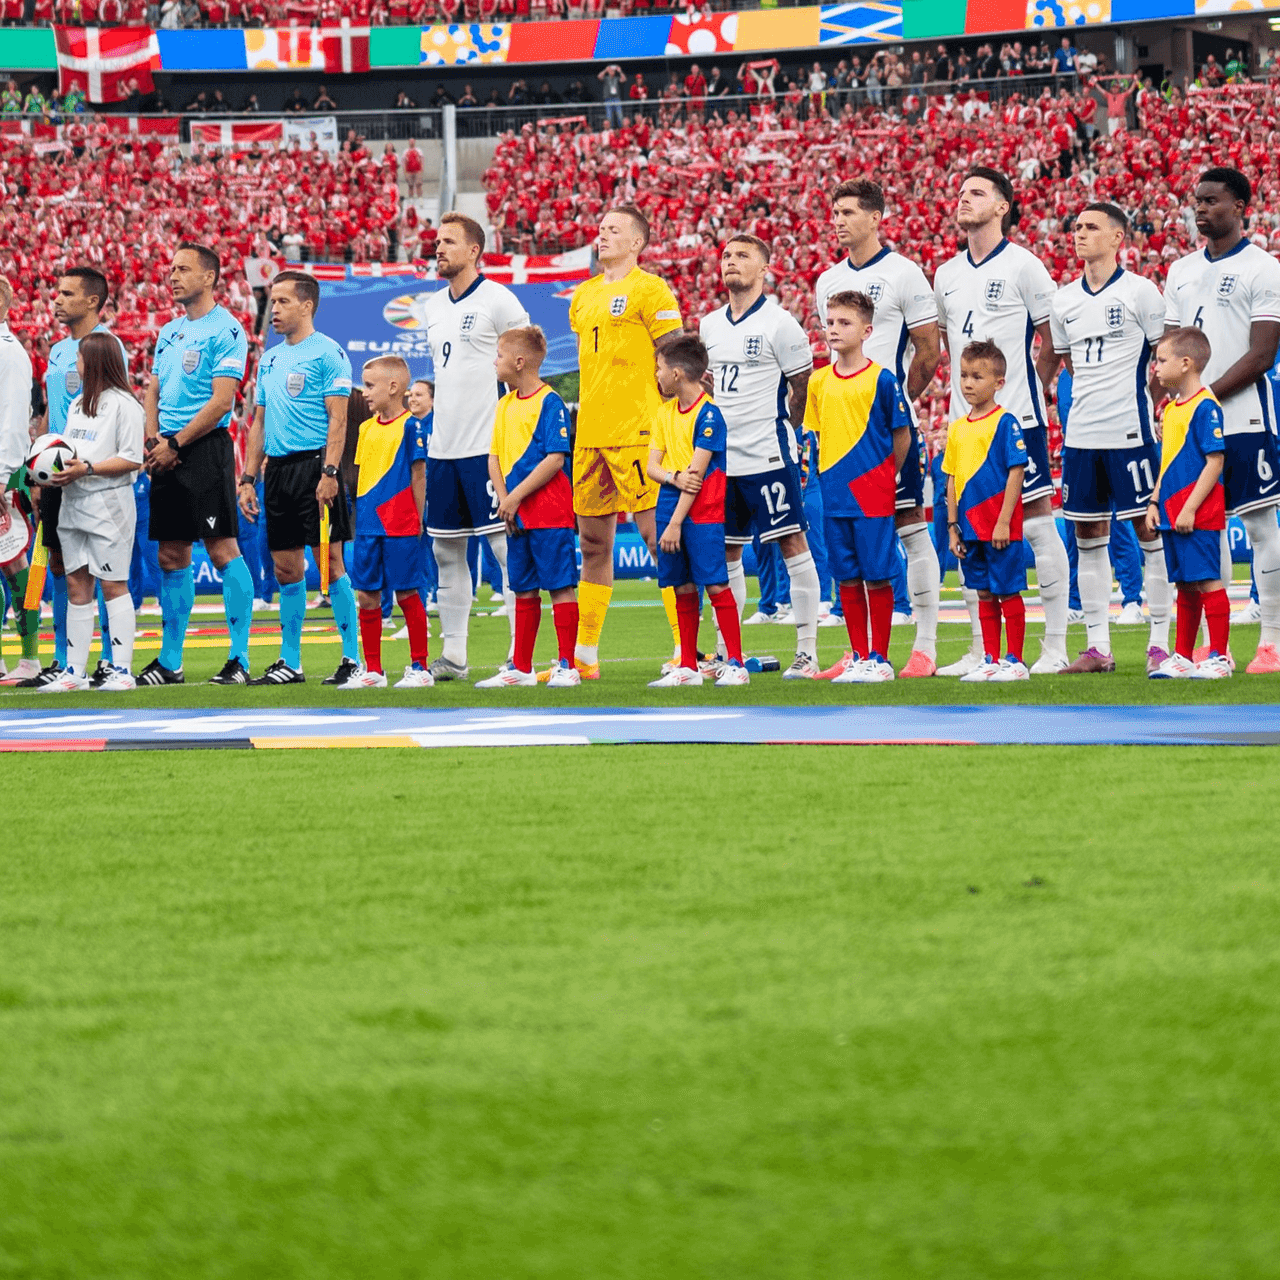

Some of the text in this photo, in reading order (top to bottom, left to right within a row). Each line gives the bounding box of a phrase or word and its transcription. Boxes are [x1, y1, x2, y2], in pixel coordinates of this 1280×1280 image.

[961, 310, 974, 338] 4
[592, 325, 600, 353] 1
[1084, 336, 1105, 363] 11
[441, 340, 452, 368] 9
[720, 364, 739, 393] 12
[632, 458, 646, 487] 1
[1126, 458, 1155, 493] 11
[1257, 448, 1273, 481] 6
[760, 481, 791, 515] 12
